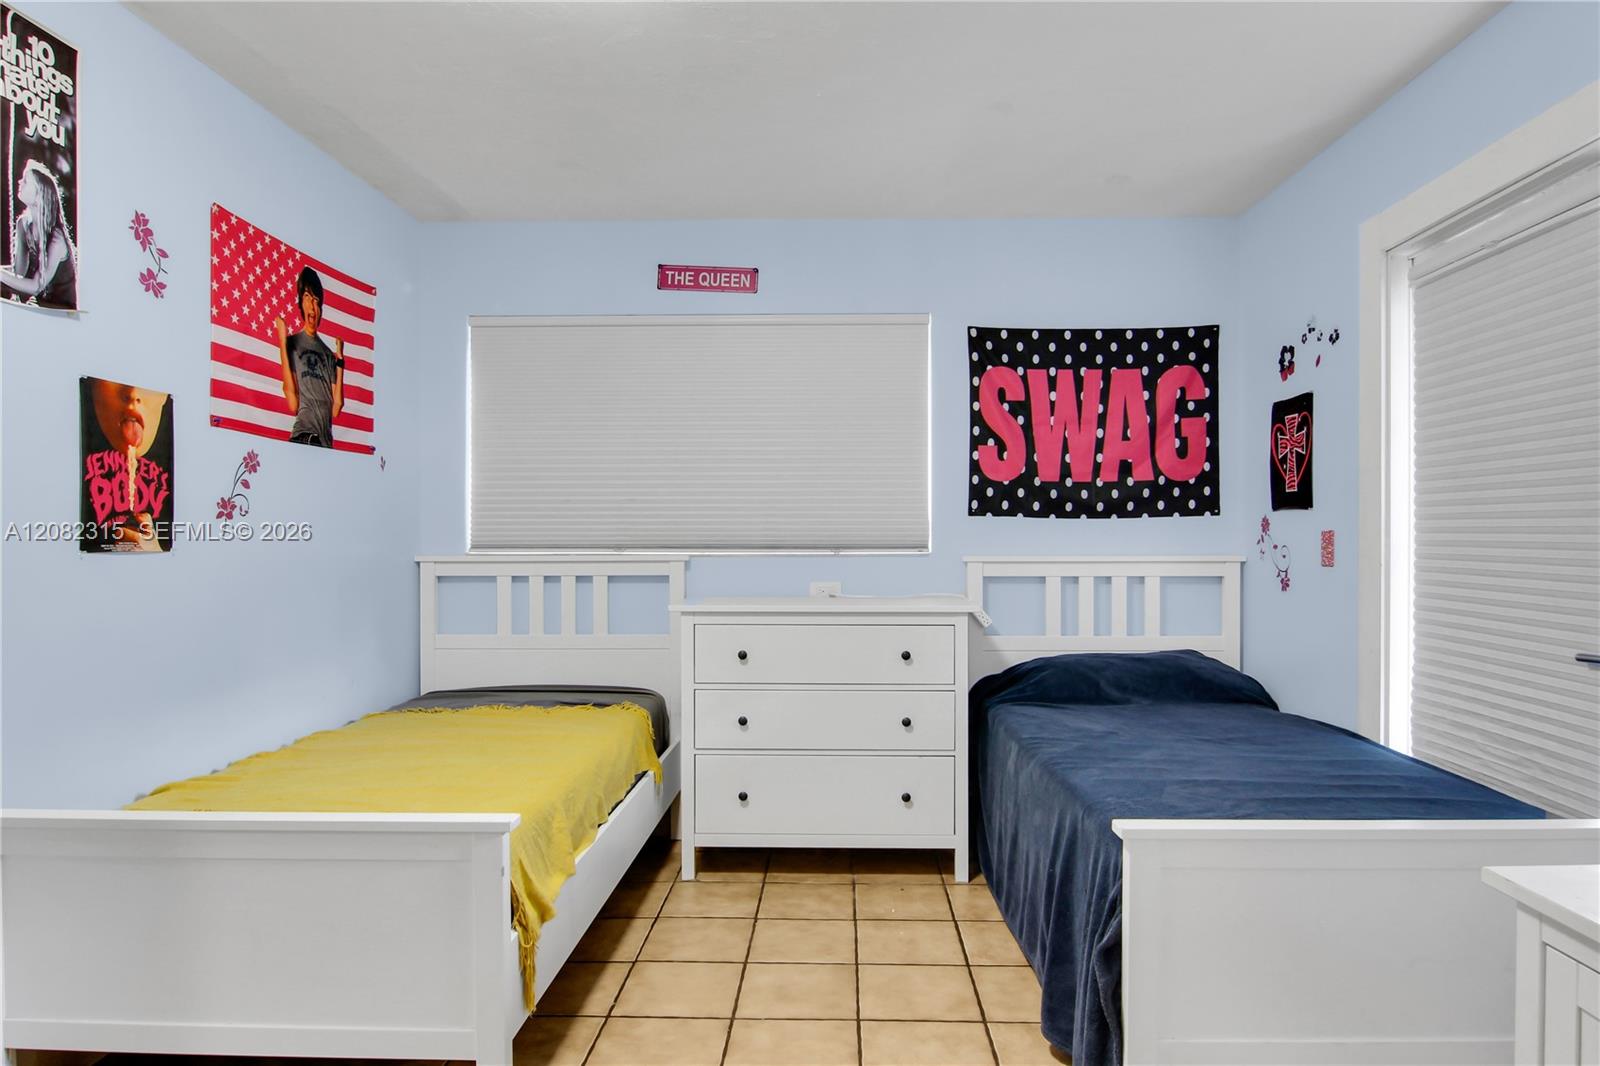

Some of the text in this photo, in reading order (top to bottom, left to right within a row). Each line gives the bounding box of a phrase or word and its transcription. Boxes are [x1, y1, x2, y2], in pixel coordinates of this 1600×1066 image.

[0, 32, 74, 96] things
[28, 35, 55, 67] 10
[25, 109, 65, 147] you
[665, 271, 751, 288] THE QUEEN
[977, 364, 1208, 483] SWAG
[84, 449, 169, 490] JENNER'S
[89, 470, 170, 526] BODY
